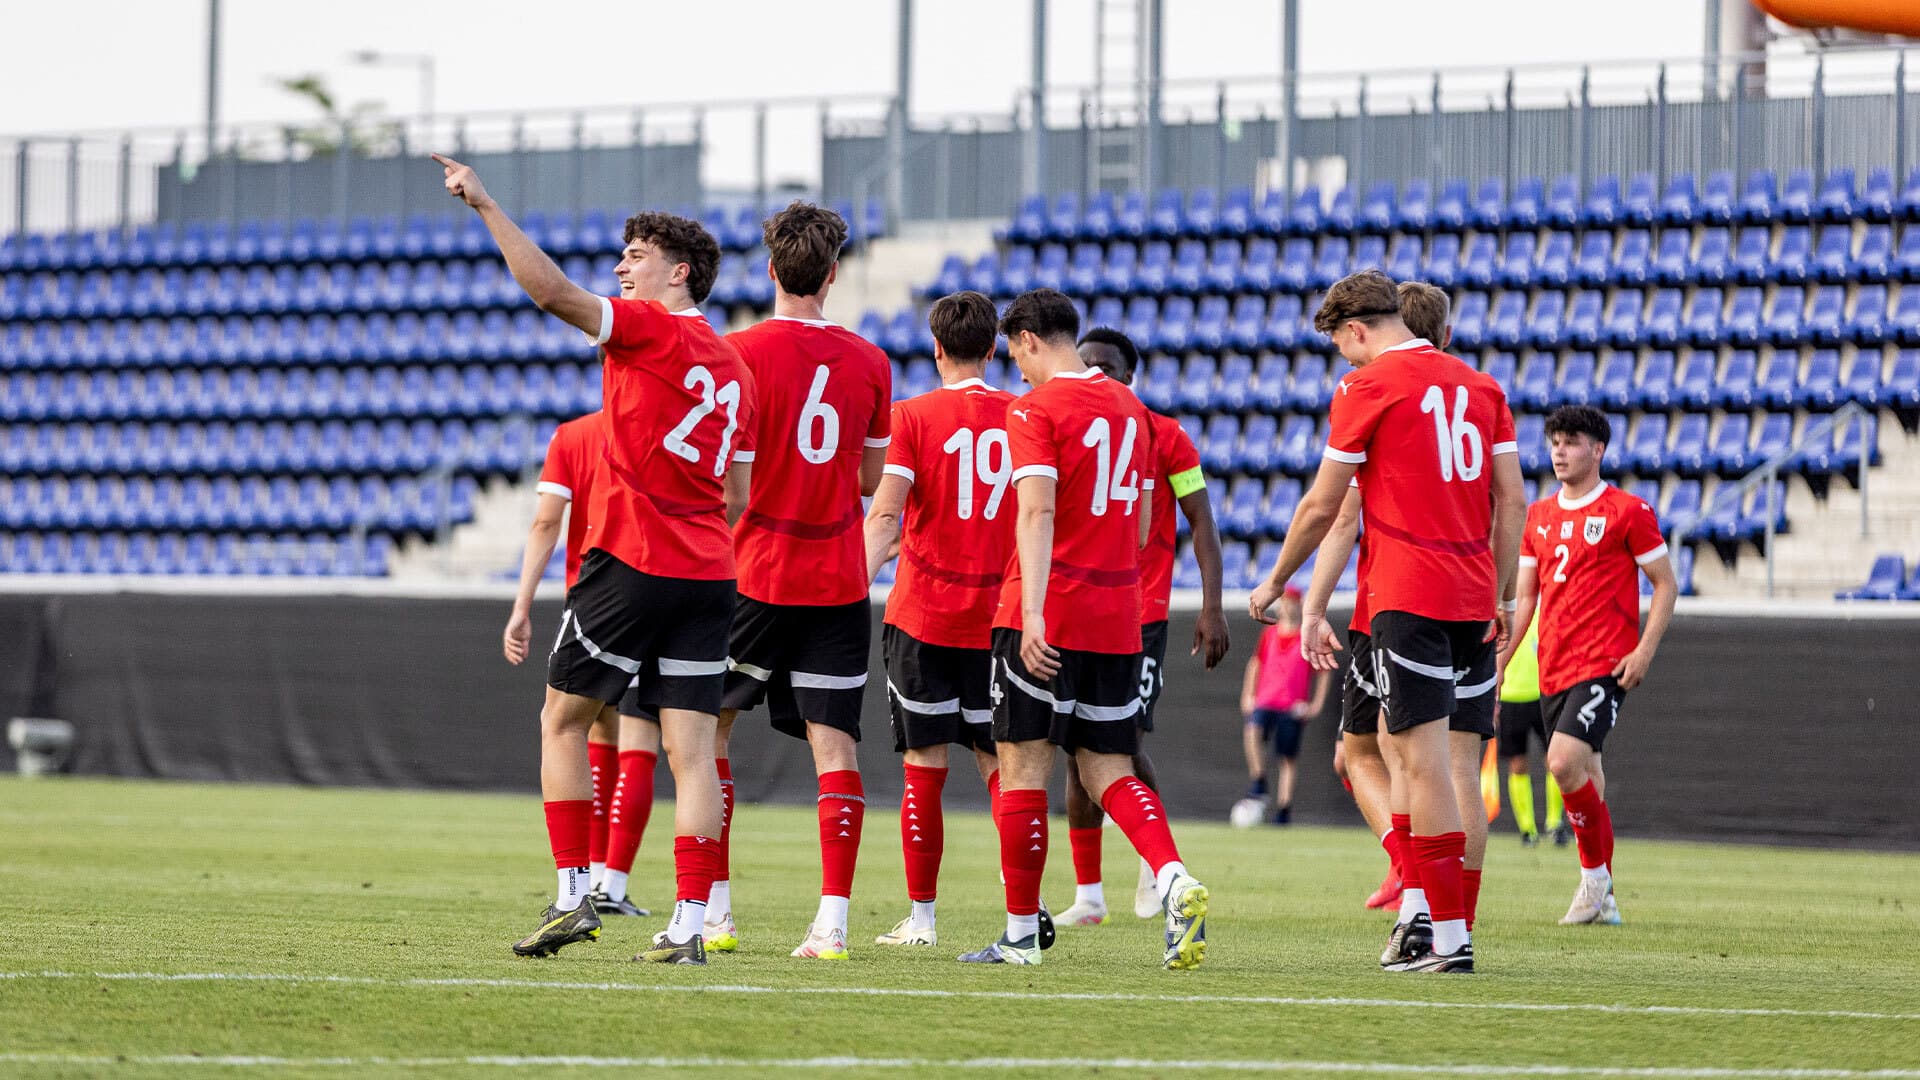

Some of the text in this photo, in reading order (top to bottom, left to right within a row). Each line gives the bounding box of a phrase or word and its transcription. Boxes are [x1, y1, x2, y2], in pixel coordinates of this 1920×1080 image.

[664, 366, 741, 477] 21
[797, 364, 840, 465] 6
[1421, 385, 1484, 483] 16
[943, 427, 1013, 521] 19
[1082, 416, 1139, 517] 14
[1552, 544, 1570, 583] 2
[1138, 656, 1157, 698] 5
[1580, 684, 1605, 720] 2
